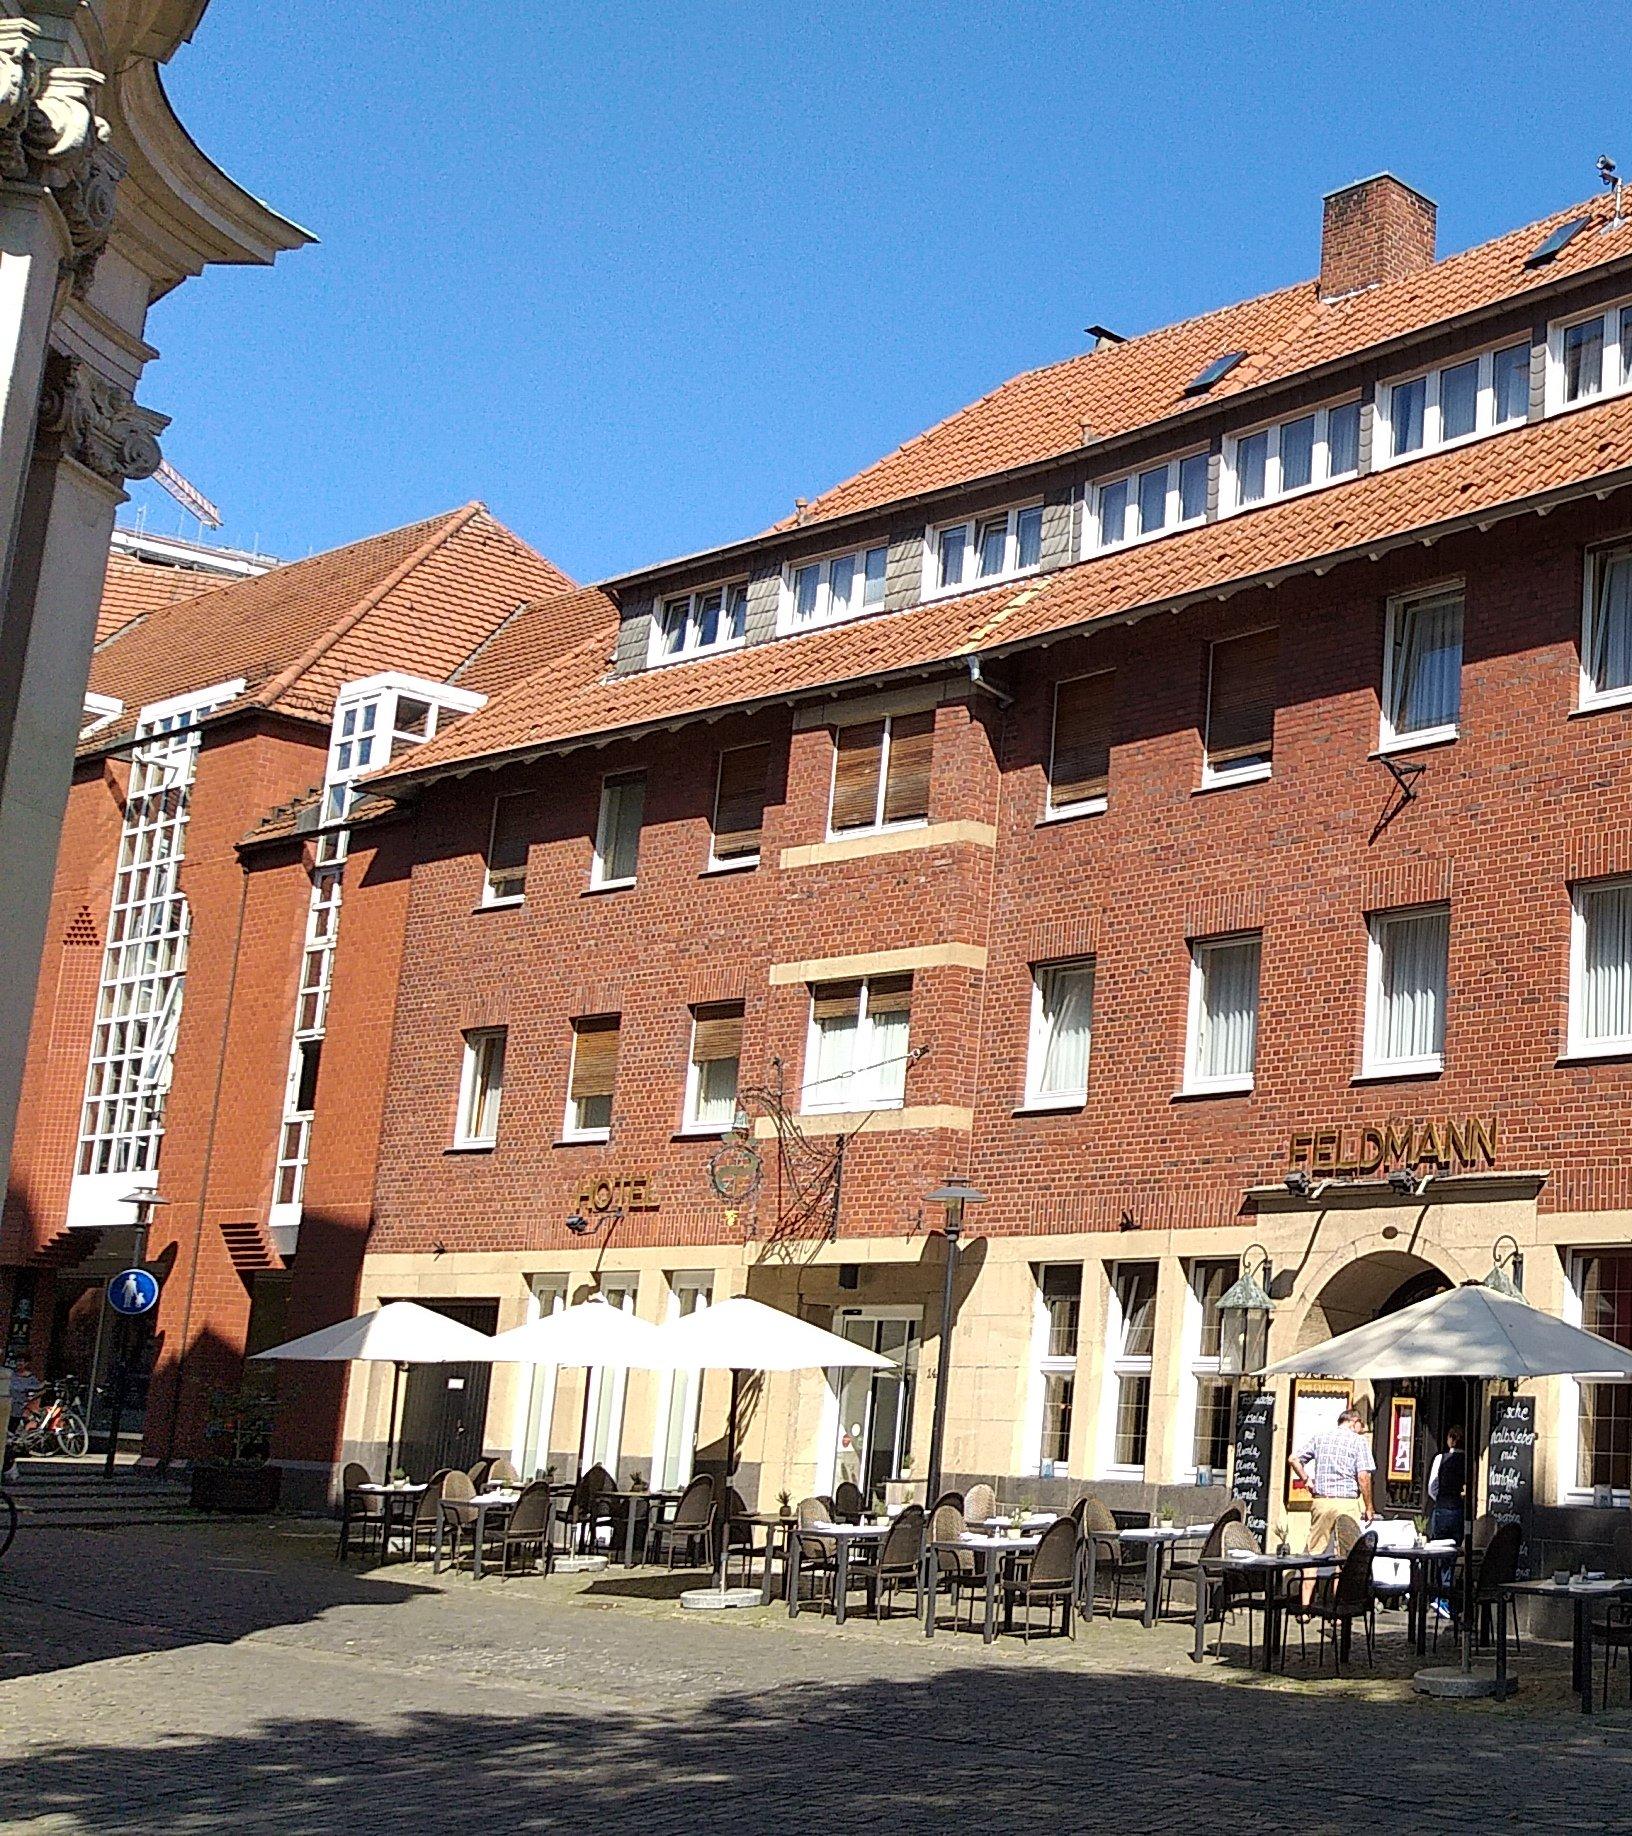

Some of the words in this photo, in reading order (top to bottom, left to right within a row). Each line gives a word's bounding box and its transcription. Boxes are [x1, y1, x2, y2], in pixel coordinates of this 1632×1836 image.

[1289, 1117, 1498, 1178] FELDMANN
[576, 1175, 660, 1214] HOTEL
[1500, 1445, 1518, 1461] mit
